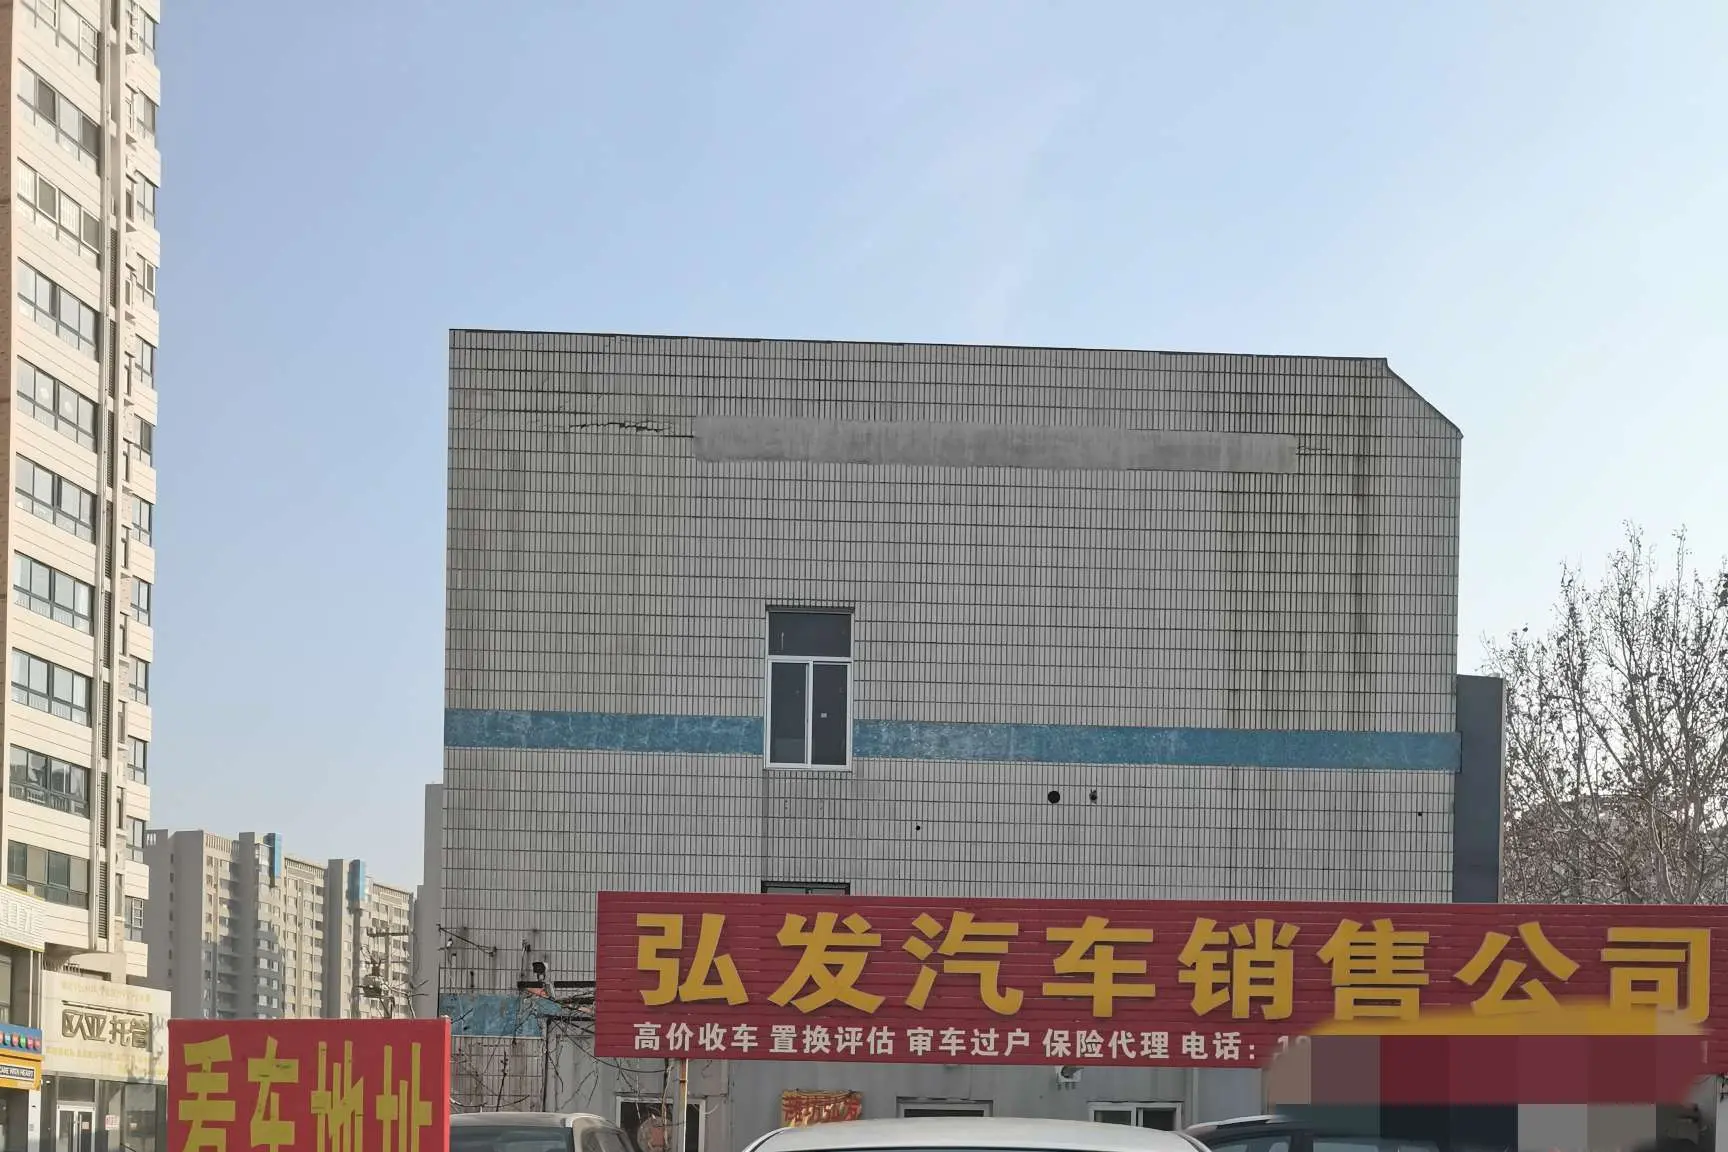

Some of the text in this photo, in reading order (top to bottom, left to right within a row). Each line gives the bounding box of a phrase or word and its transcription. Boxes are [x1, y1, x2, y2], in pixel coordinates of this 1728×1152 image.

[636, 911, 1711, 1024] 弘发汽车销售公司
[633, 1022, 760, 1052] 高价收车
[769, 1024, 896, 1056] 置换评估
[906, 1026, 1031, 1058] 审车过户
[1042, 1028, 1170, 1060] 保险代理
